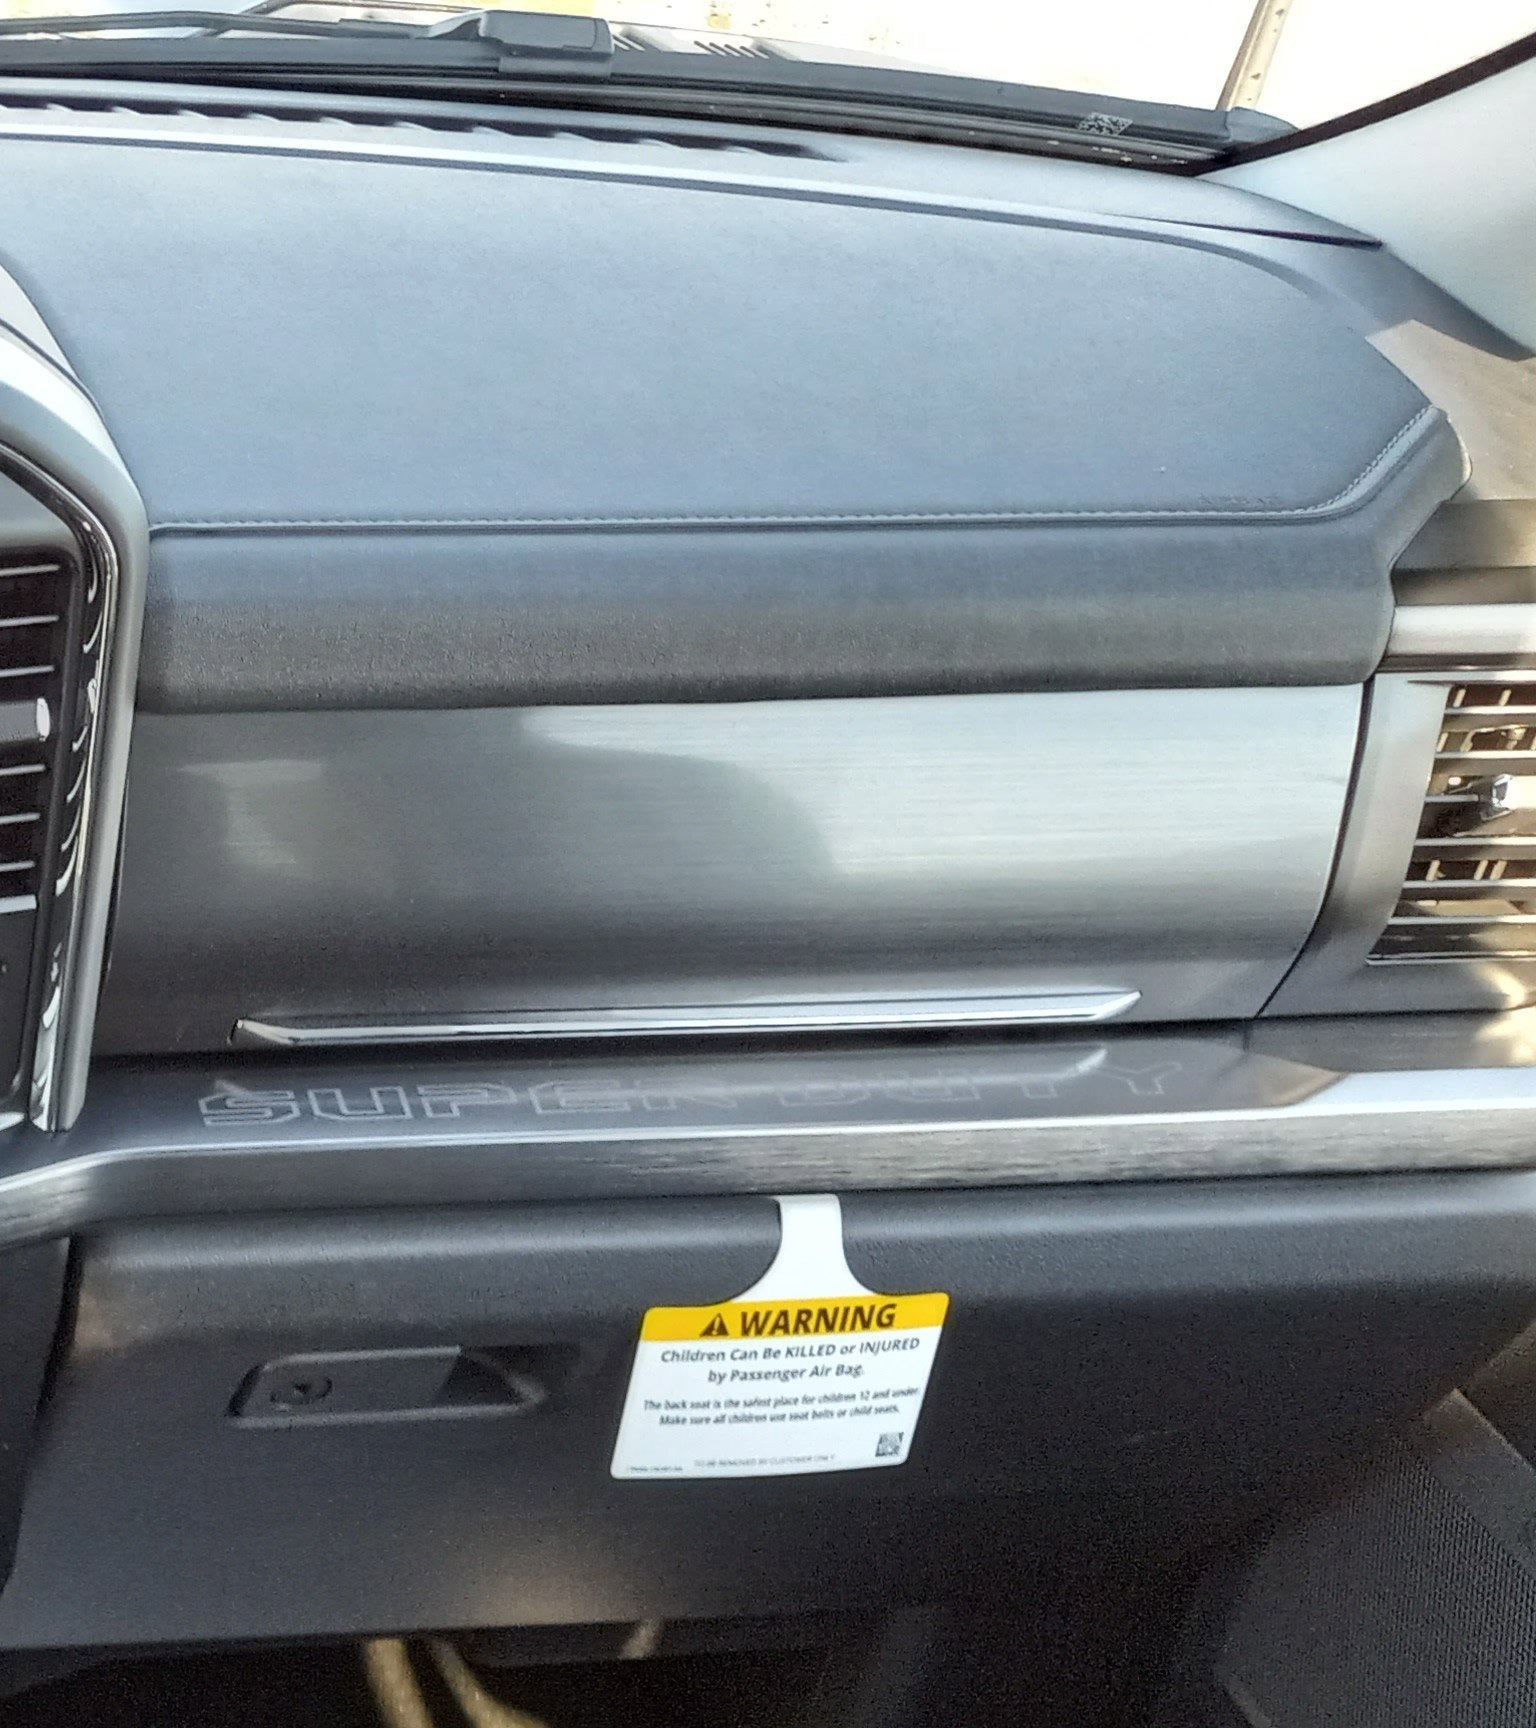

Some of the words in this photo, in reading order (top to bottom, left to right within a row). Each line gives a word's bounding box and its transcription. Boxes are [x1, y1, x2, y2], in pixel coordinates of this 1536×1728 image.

[740, 1303, 897, 1337] WARNING
[660, 1347, 726, 1363] Children
[730, 1347, 759, 1361] Can
[762, 1346, 780, 1360] Be
[785, 1343, 836, 1358] KILLED
[840, 1344, 856, 1356] or
[859, 1337, 920, 1355] INJURED
[708, 1368, 726, 1384] by
[730, 1368, 806, 1383] Passenger
[809, 1365, 831, 1378] Air
[835, 1363, 865, 1378] Bag.
[644, 1399, 661, 1411] The
[664, 1398, 687, 1410] back
[690, 1399, 710, 1409] seat
[712, 1398, 721, 1409] is
[723, 1397, 740, 1408] the
[742, 1395, 771, 1408] safest
[773, 1394, 799, 1409] place
[801, 1393, 816, 1405] for
[818, 1391, 857, 1405] children
[860, 1390, 870, 1401] 12
[873, 1389, 890, 1400] and
[659, 1414, 687, 1426] Make
[689, 1415, 710, 1425] sure
[712, 1412, 726, 1424] all
[728, 1411, 767, 1424] children
[770, 1412, 786, 1422] use
[789, 1410, 809, 1421] seat
[811, 1408, 834, 1420] belts
[836, 1408, 847, 1418] or
[849, 1405, 872, 1417] child
